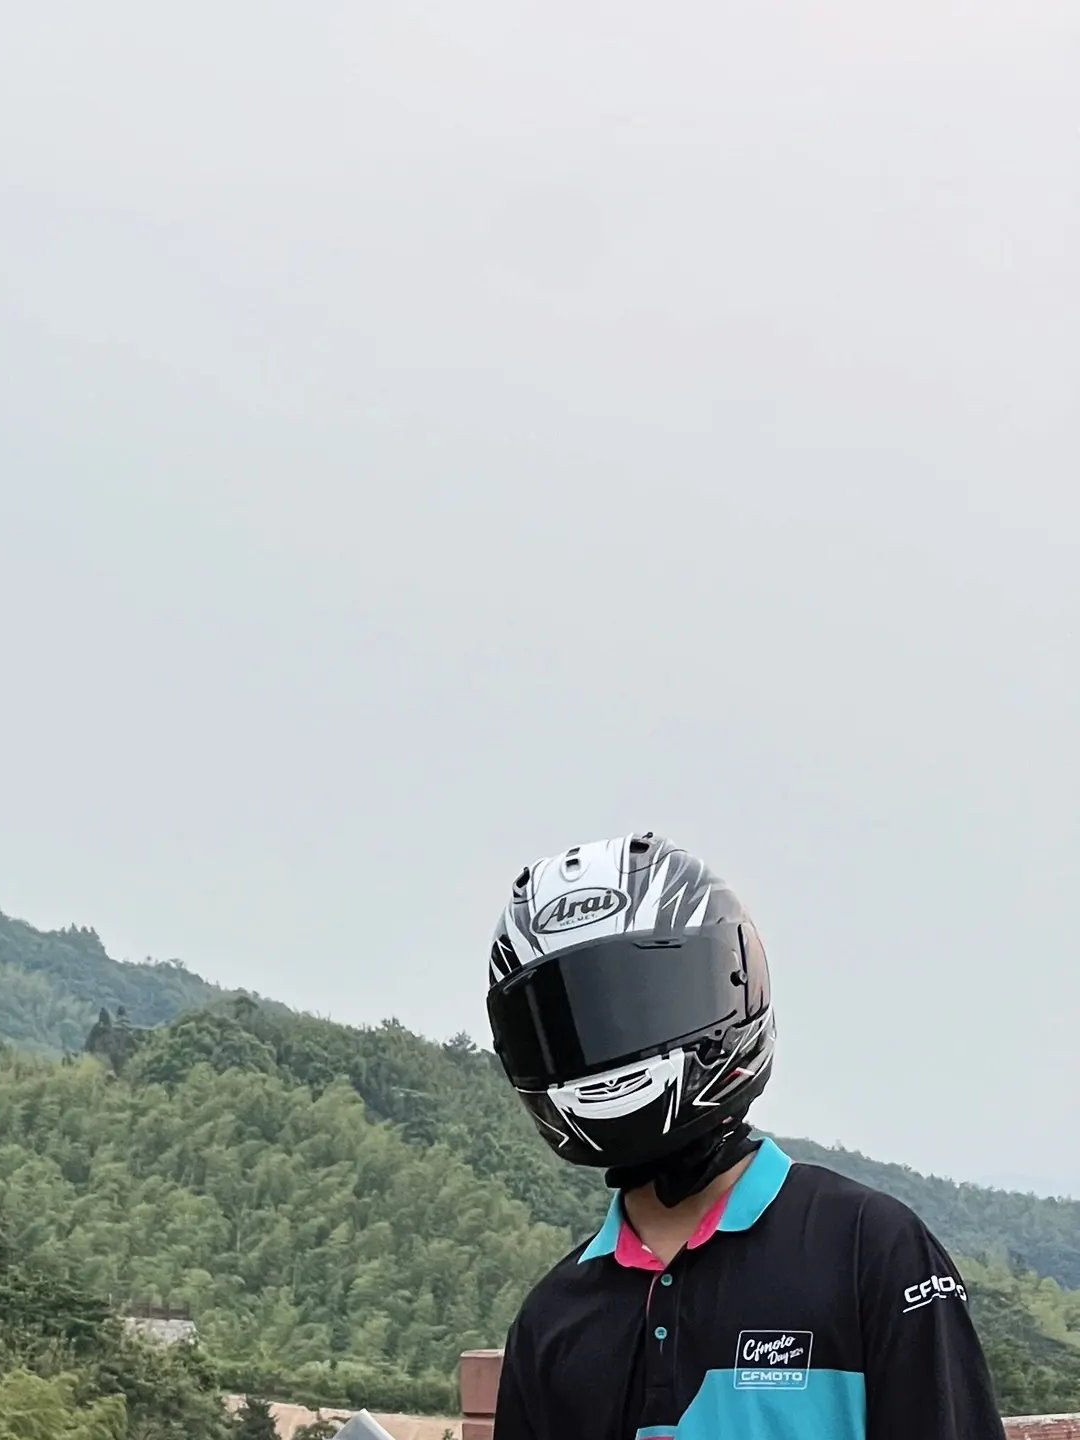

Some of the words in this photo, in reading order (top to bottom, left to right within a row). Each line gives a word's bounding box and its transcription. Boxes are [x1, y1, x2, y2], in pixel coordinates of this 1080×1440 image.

[539, 890, 614, 930] Arai
[743, 1334, 796, 1362] Cfmoto
[767, 1351, 789, 1366] Day
[741, 1371, 803, 1381] CFMOTO
